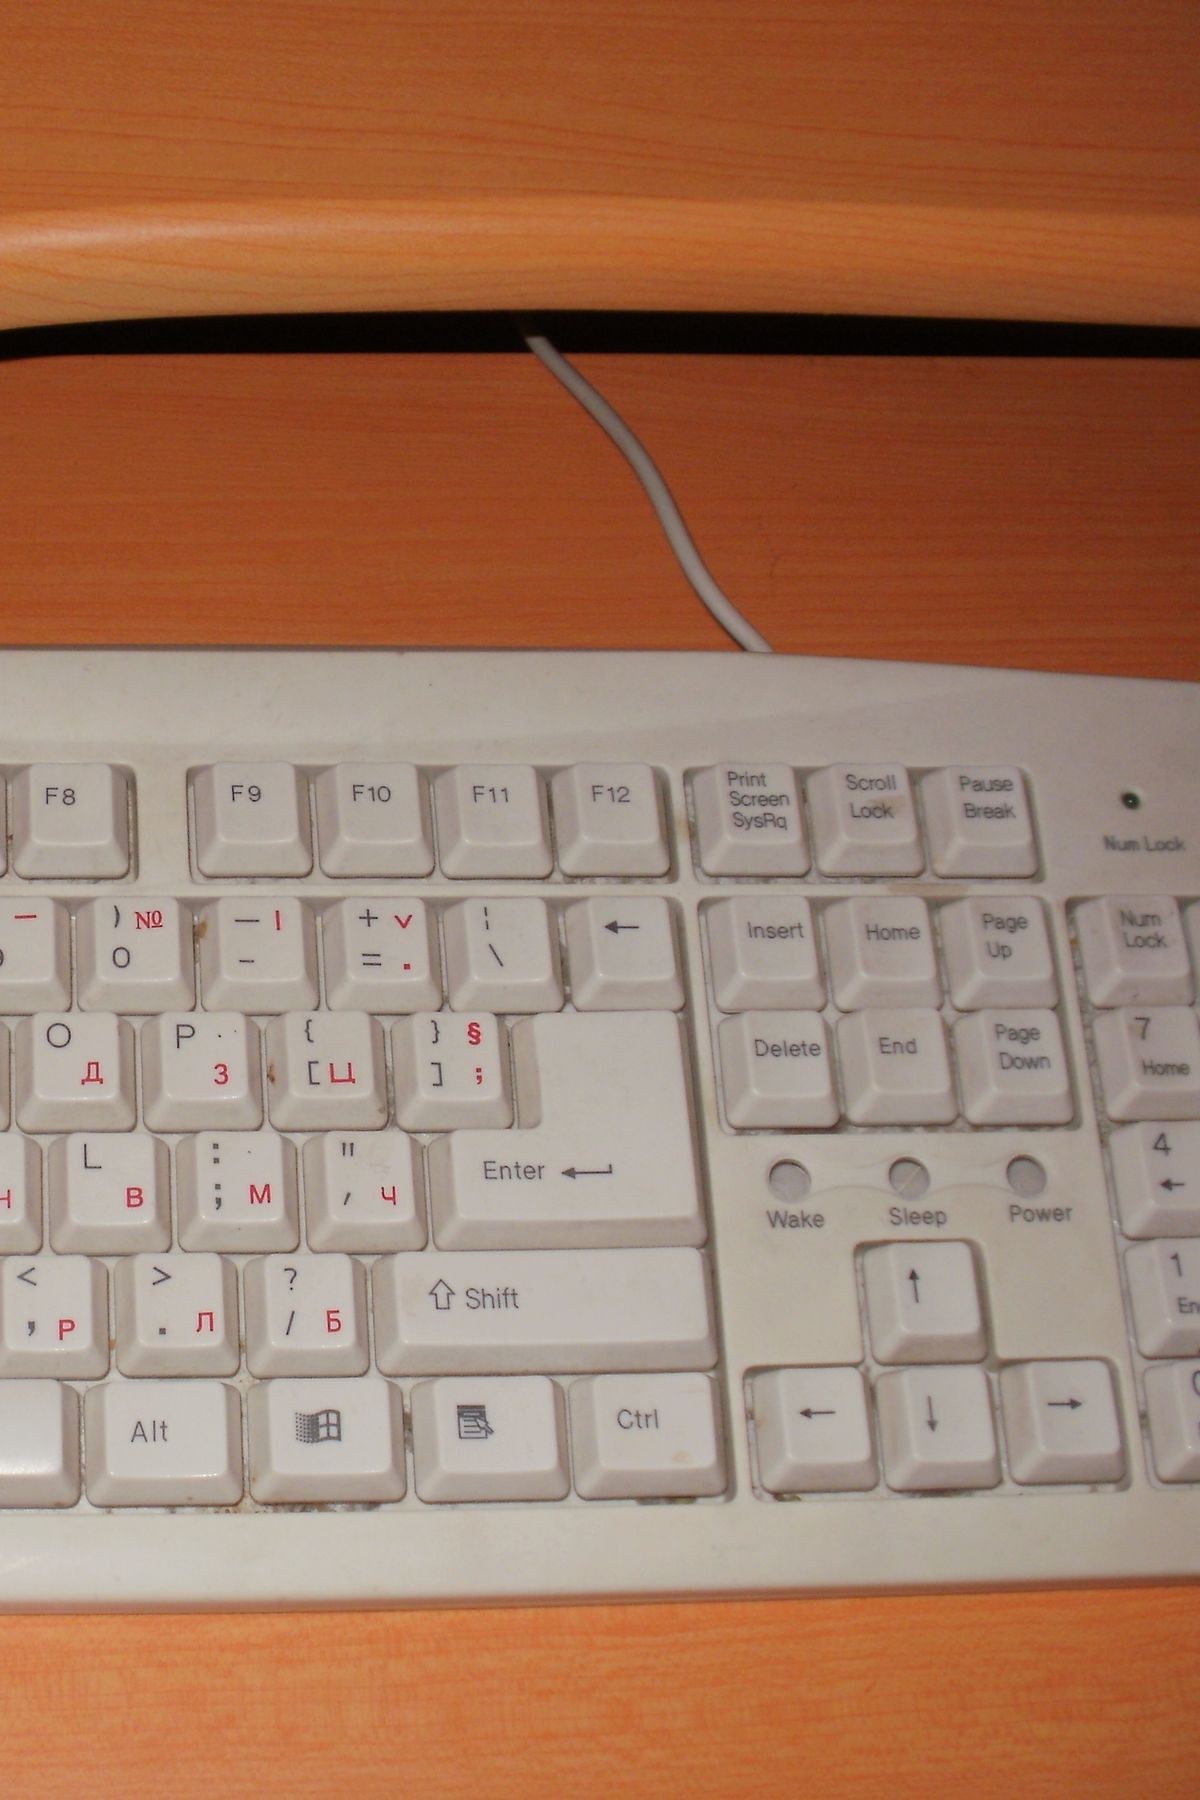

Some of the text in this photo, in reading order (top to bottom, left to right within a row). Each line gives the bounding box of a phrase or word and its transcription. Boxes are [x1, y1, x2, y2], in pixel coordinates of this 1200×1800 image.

[726, 770, 767, 787] Print
[844, 773, 895, 792] Scroll
[957, 774, 1014, 793] Pause
[44, 786, 77, 807] F8
[230, 784, 263, 804] F9
[351, 783, 392, 804] F10
[472, 784, 510, 804] F11
[590, 784, 631, 804] F12
[728, 790, 790, 808] Screen
[731, 810, 788, 831] SysRq
[849, 801, 895, 820] Lock
[962, 801, 1016, 820] Break
[1102, 834, 1186, 853] Num Lock
[357, 907, 380, 928] +
[981, 912, 1029, 934] Page
[1117, 908, 1162, 928] Num
[746, 921, 805, 940] Insert
[864, 923, 921, 942] Home
[1122, 932, 1168, 949] Lock
[360, 952, 383, 967] =
[986, 941, 1013, 961] Up
[175, 1023, 197, 1050] P
[303, 1018, 315, 1044] {
[430, 1018, 441, 1045] }
[993, 1023, 1041, 1045] Page
[1133, 1016, 1151, 1042] 7
[753, 1038, 821, 1058] Delete
[877, 1036, 918, 1056] End
[998, 1051, 1051, 1071] Down
[1140, 1059, 1192, 1077] Home
[307, 1059, 321, 1086] [
[429, 1061, 444, 1088] ]
[1151, 1132, 1173, 1157] 4
[82, 1142, 103, 1171] L
[482, 1159, 546, 1181] Enter
[765, 1210, 826, 1229] Wake
[888, 1206, 948, 1228] Sleep
[1008, 1203, 1073, 1223] Power
[1169, 1251, 1183, 1278] 1
[16, 1266, 38, 1287] <
[151, 1265, 173, 1287] >
[283, 1266, 298, 1292] ?
[464, 1286, 520, 1311] Shift
[1176, 1296, 1200, 1315] En
[616, 1407, 660, 1431] Ctrl
[130, 1419, 169, 1444] Alt
